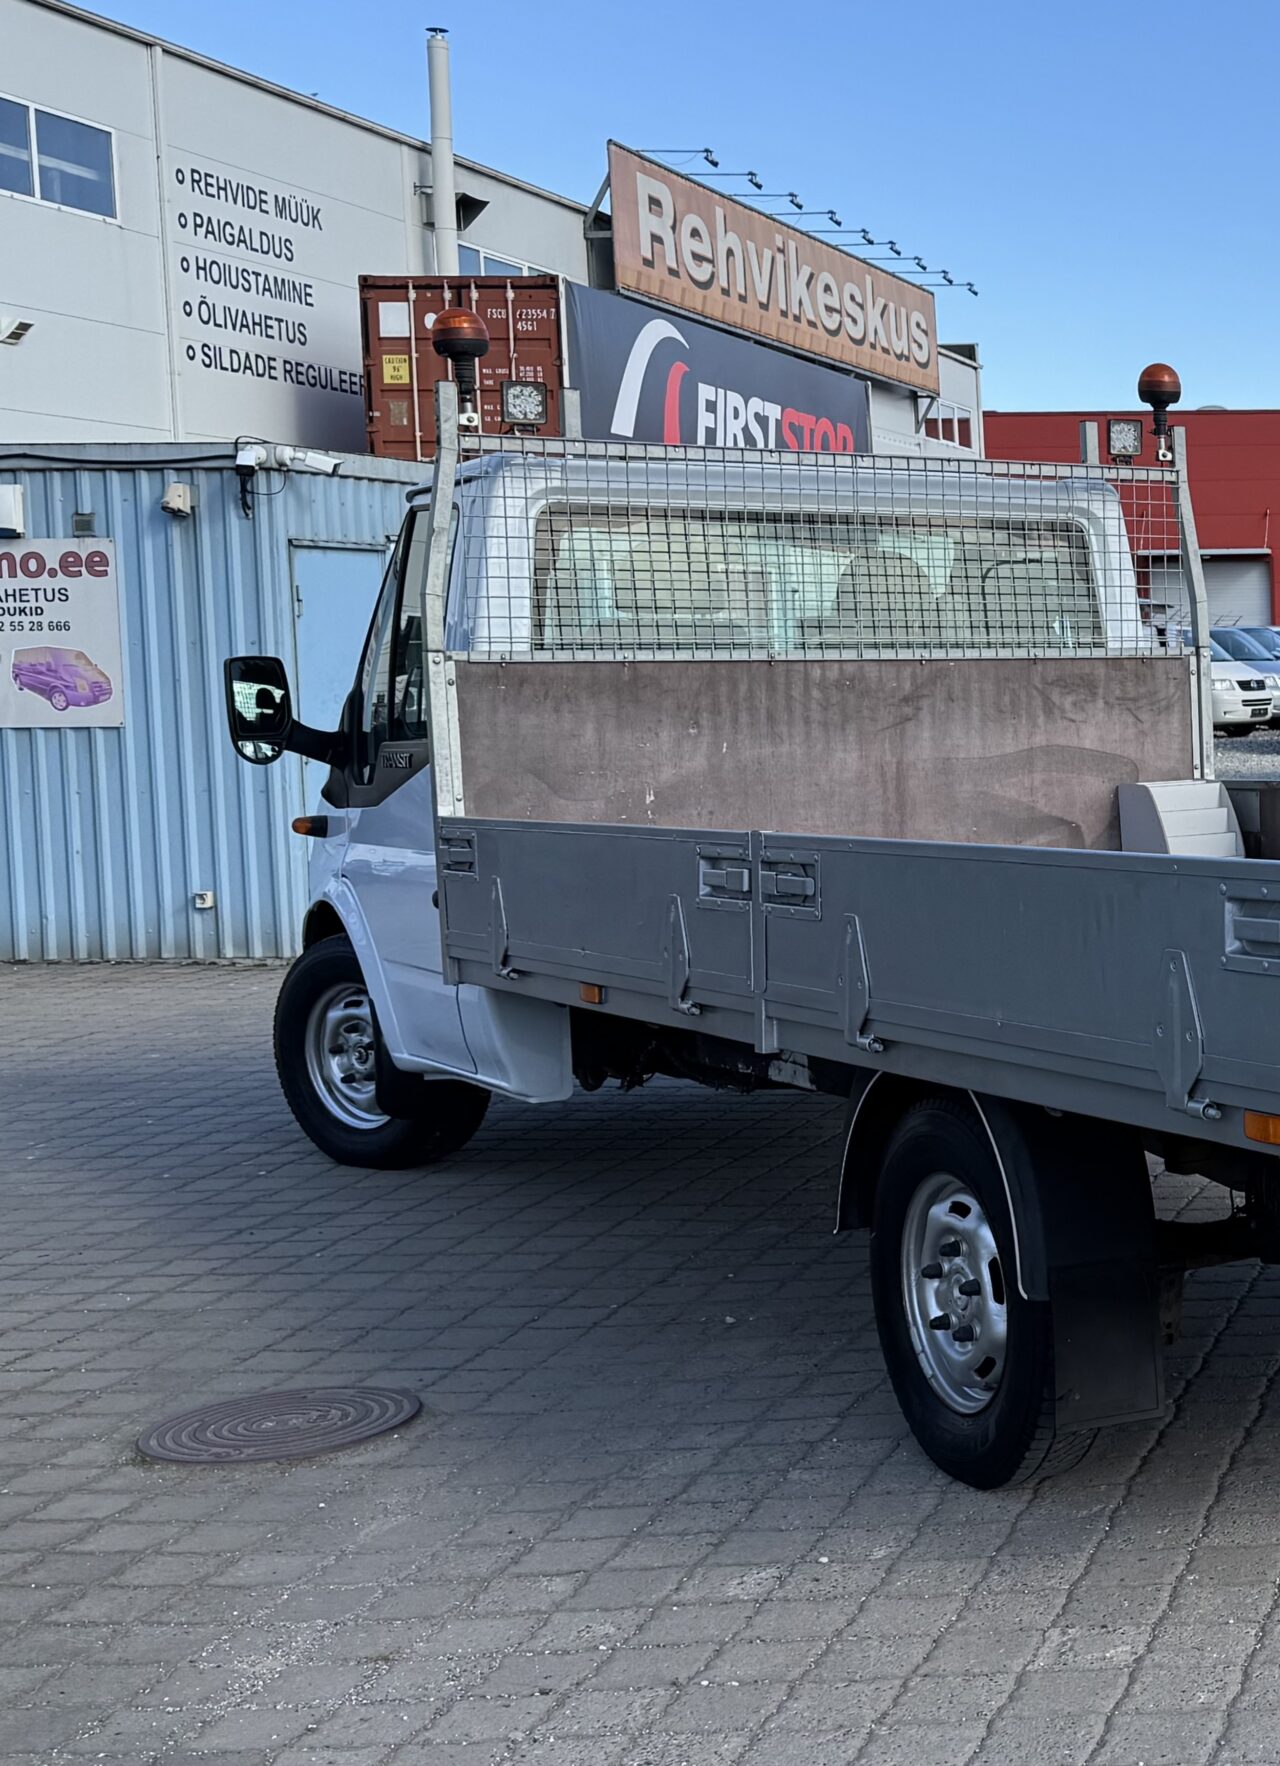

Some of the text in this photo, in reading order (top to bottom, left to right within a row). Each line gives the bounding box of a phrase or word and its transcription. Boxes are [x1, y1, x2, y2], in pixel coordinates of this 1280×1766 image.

[191, 168, 323, 231] REHVIDE MÜÜK
[193, 212, 294, 262] PAIGALDUS
[195, 256, 314, 308] HOIUSTAMINE
[635, 170, 931, 369] Rehvikeskus
[198, 295, 308, 346] ÕLIVAHETUS
[201, 343, 278, 381] SILDADE
[9, 621, 25, 632] 55
[28, 621, 44, 632] 28
[47, 621, 71, 632] 666
